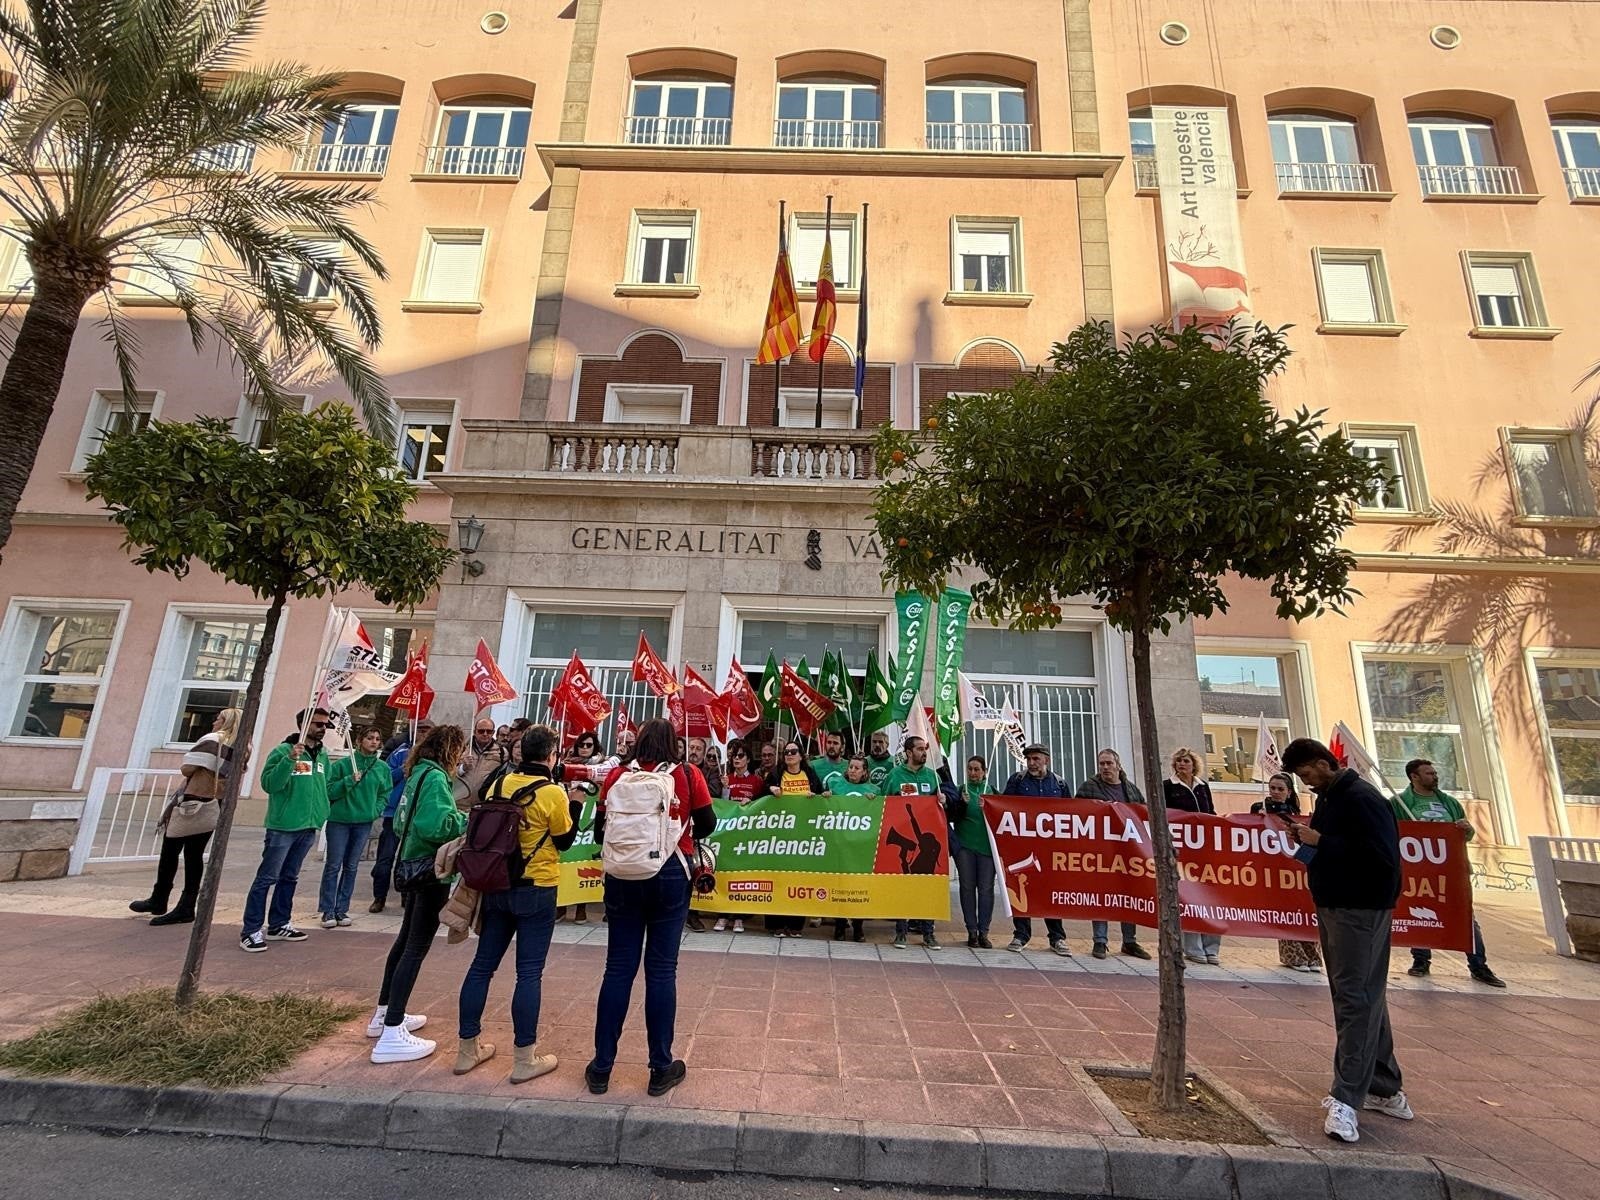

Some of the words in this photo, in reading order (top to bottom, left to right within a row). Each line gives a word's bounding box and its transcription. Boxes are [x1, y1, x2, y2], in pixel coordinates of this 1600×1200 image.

[1173, 111, 1198, 185] rupestre
[1191, 111, 1217, 185] valencià
[1180, 190, 1199, 219] Art
[572, 528, 782, 554] GENERALITAT
[846, 535, 883, 559] VA
[903, 621, 920, 687] CSIF
[943, 620, 959, 683] CSIF
[714, 811, 796, 831] rocràcia
[808, 811, 872, 831] -ràtios
[733, 836, 827, 856] +valencià
[996, 811, 1096, 840] ALCEM
[1103, 815, 1143, 844] LA
[1213, 826, 1222, 851] I
[1231, 827, 1300, 858] DIGU
[1399, 836, 1447, 865] OU
[728, 892, 773, 903] educació
[730, 882, 760, 890] CCOO
[788, 886, 815, 899] UGT
[1264, 868, 1272, 888] I
[1402, 875, 1447, 903] JA!
[1052, 891, 1101, 907] PERSONAL
[1104, 894, 1155, 914] D'ATENCIÓ
[1179, 903, 1210, 919] CATIVA
[1211, 906, 1215, 919] I
[1217, 906, 1303, 925] D'ADMINISTRACIÓ
[1391, 918, 1445, 929] INTERSINDICAL
